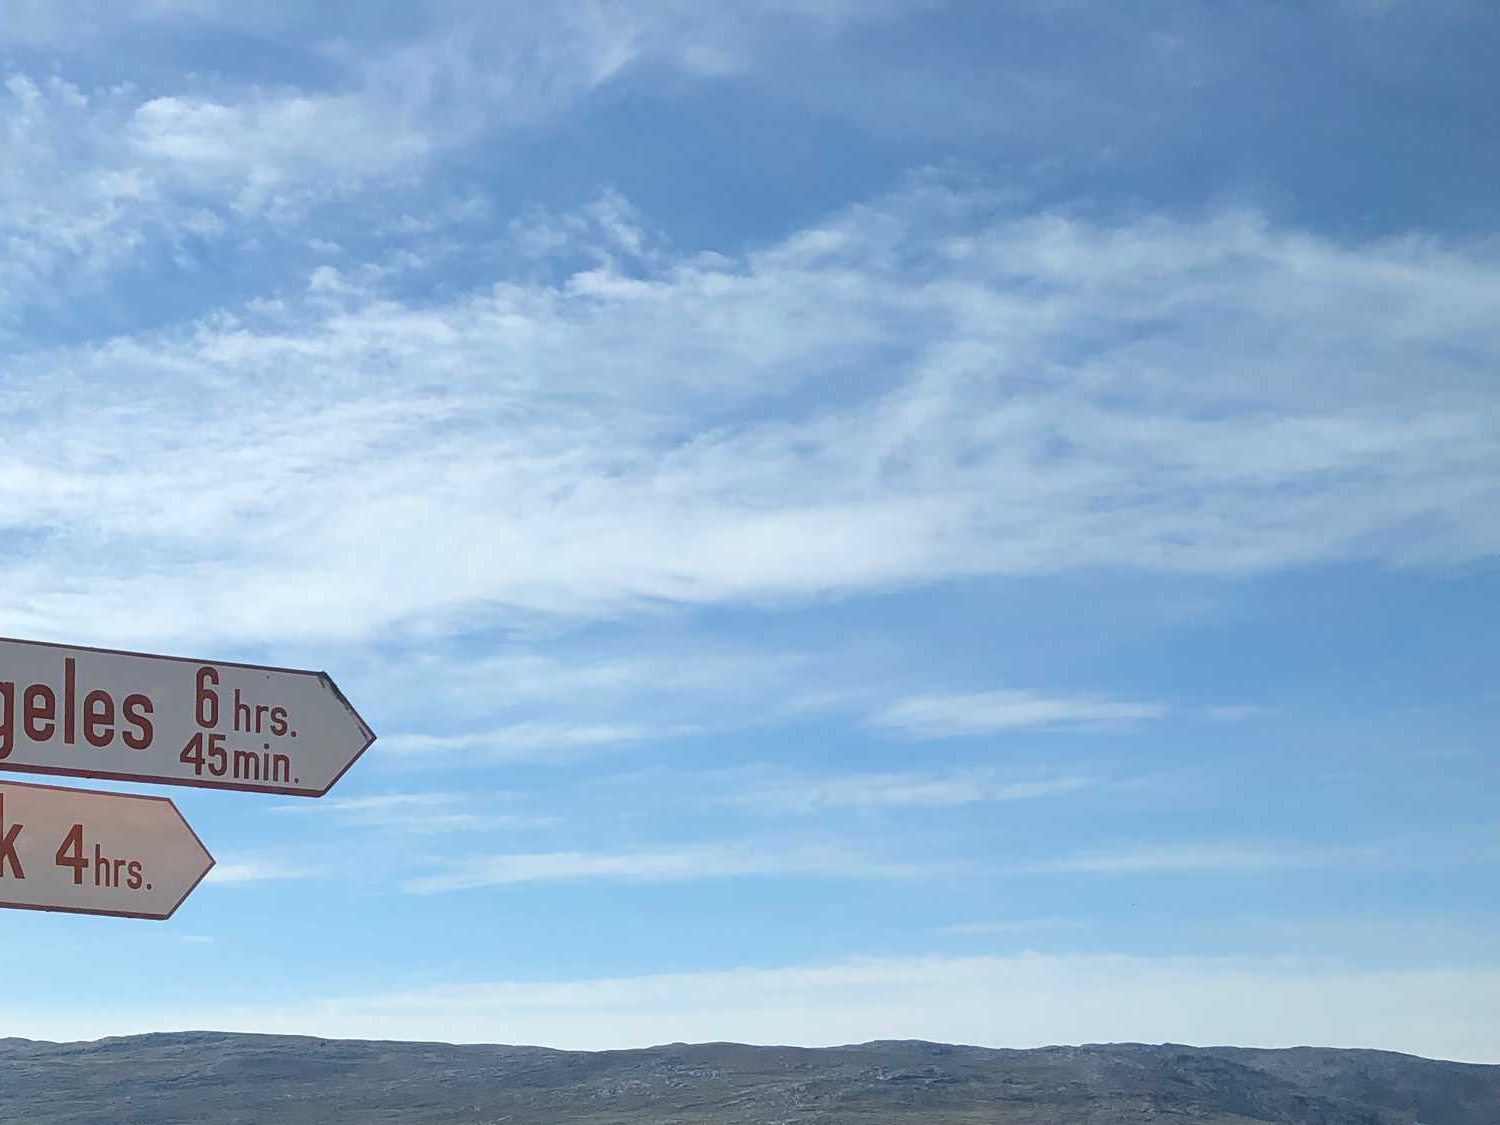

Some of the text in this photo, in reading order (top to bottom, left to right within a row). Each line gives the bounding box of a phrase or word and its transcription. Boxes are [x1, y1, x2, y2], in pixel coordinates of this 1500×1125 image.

[194, 666, 220, 730] 6
[233, 688, 298, 740] hrs.
[179, 732, 301, 785] 45 min.
[55, 823, 89, 886] 4
[93, 843, 153, 892] hrs.
